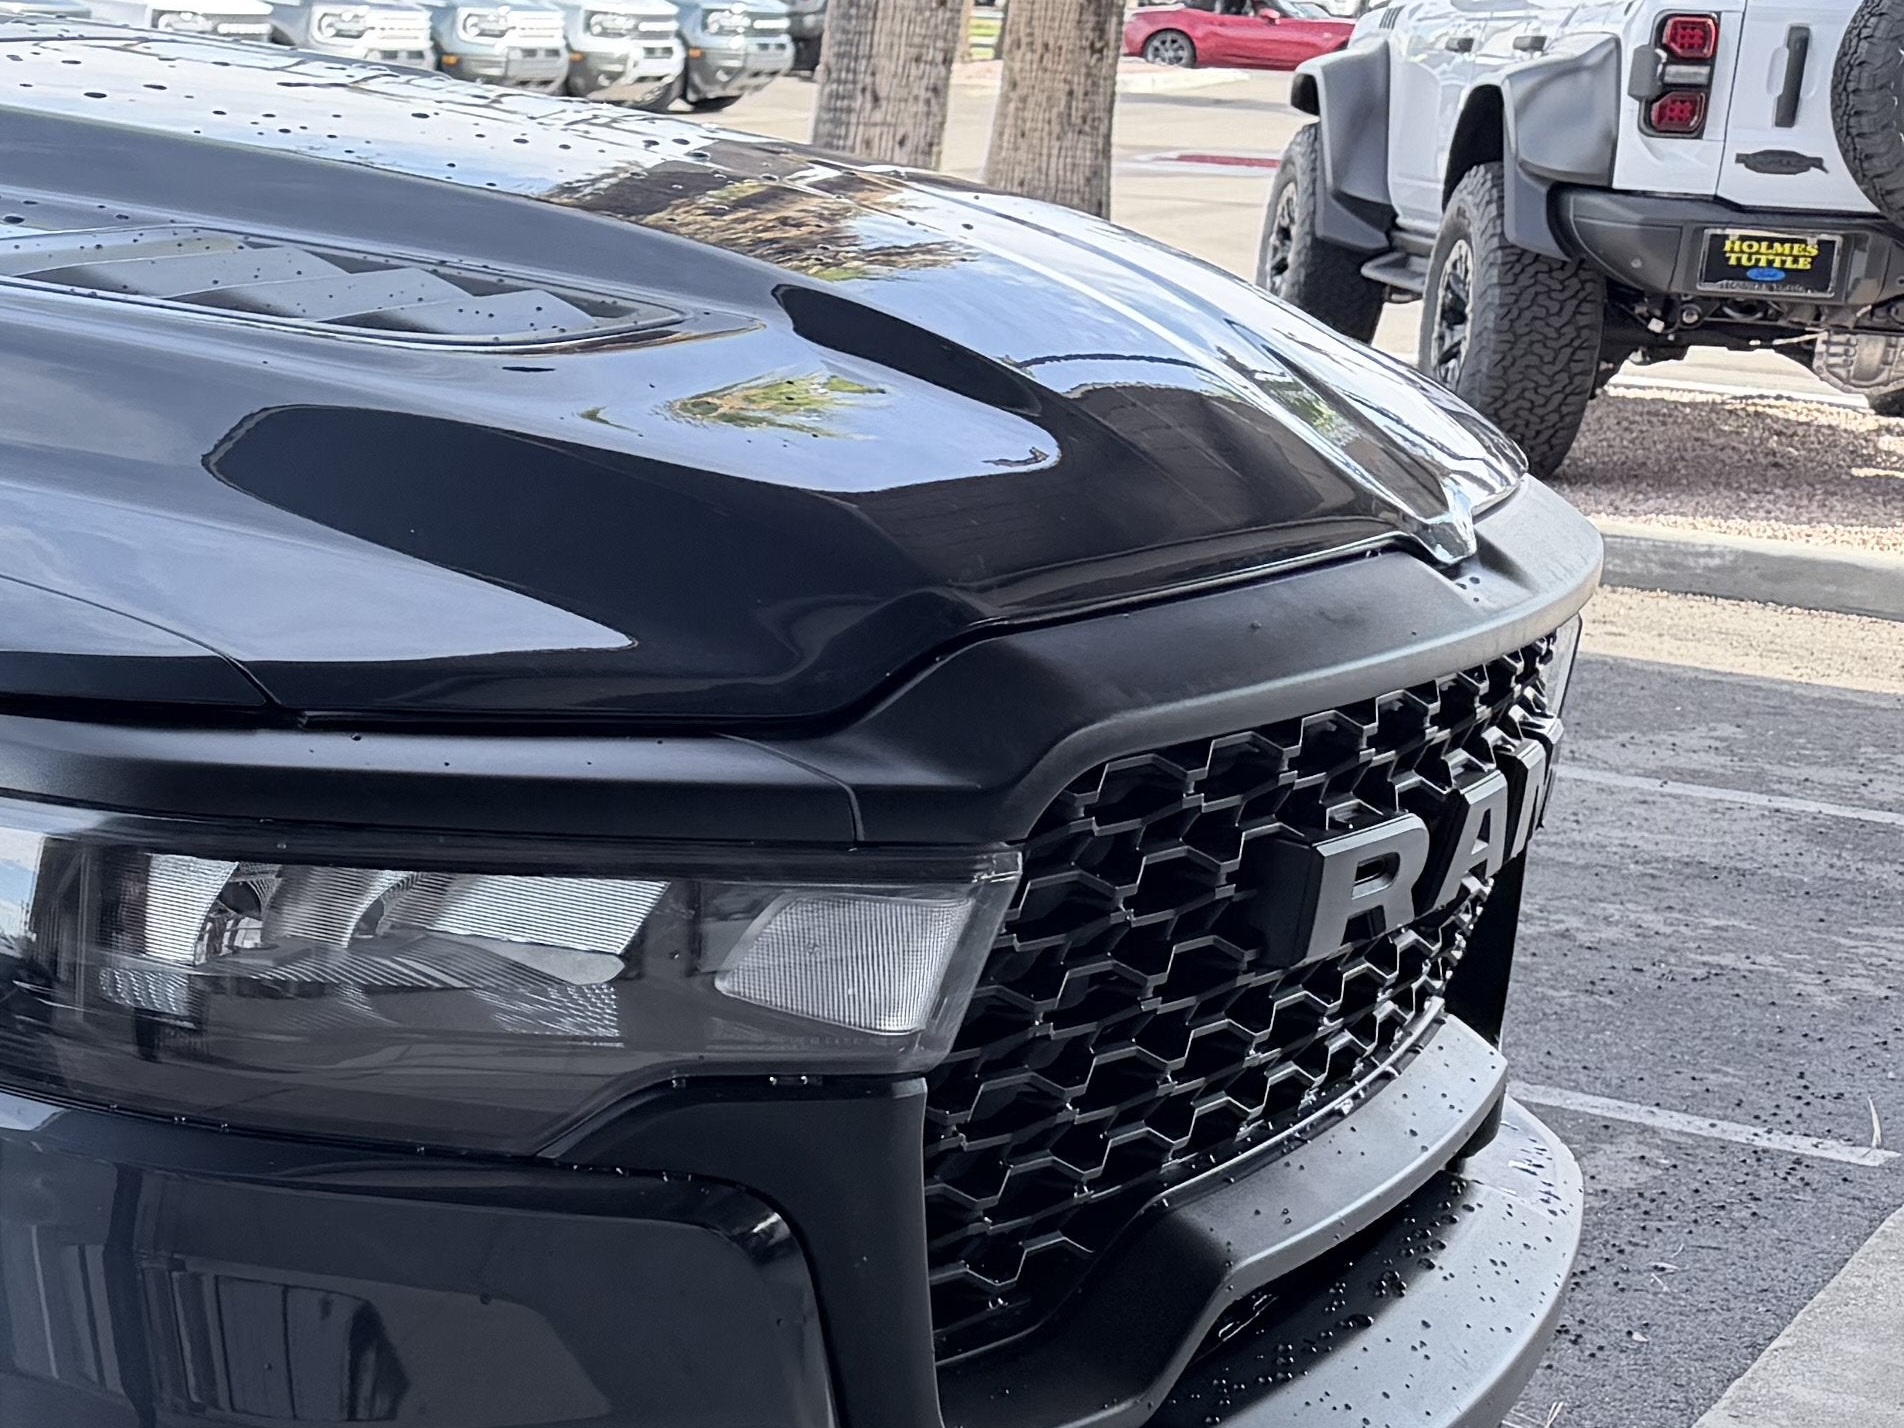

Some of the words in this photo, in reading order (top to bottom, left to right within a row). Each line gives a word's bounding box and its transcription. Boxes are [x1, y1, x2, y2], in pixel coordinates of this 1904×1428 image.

[1723, 239, 1819, 257] HOLMES
[1725, 252, 1812, 269] TUTTLE
[1297, 717, 1564, 964] RAM
